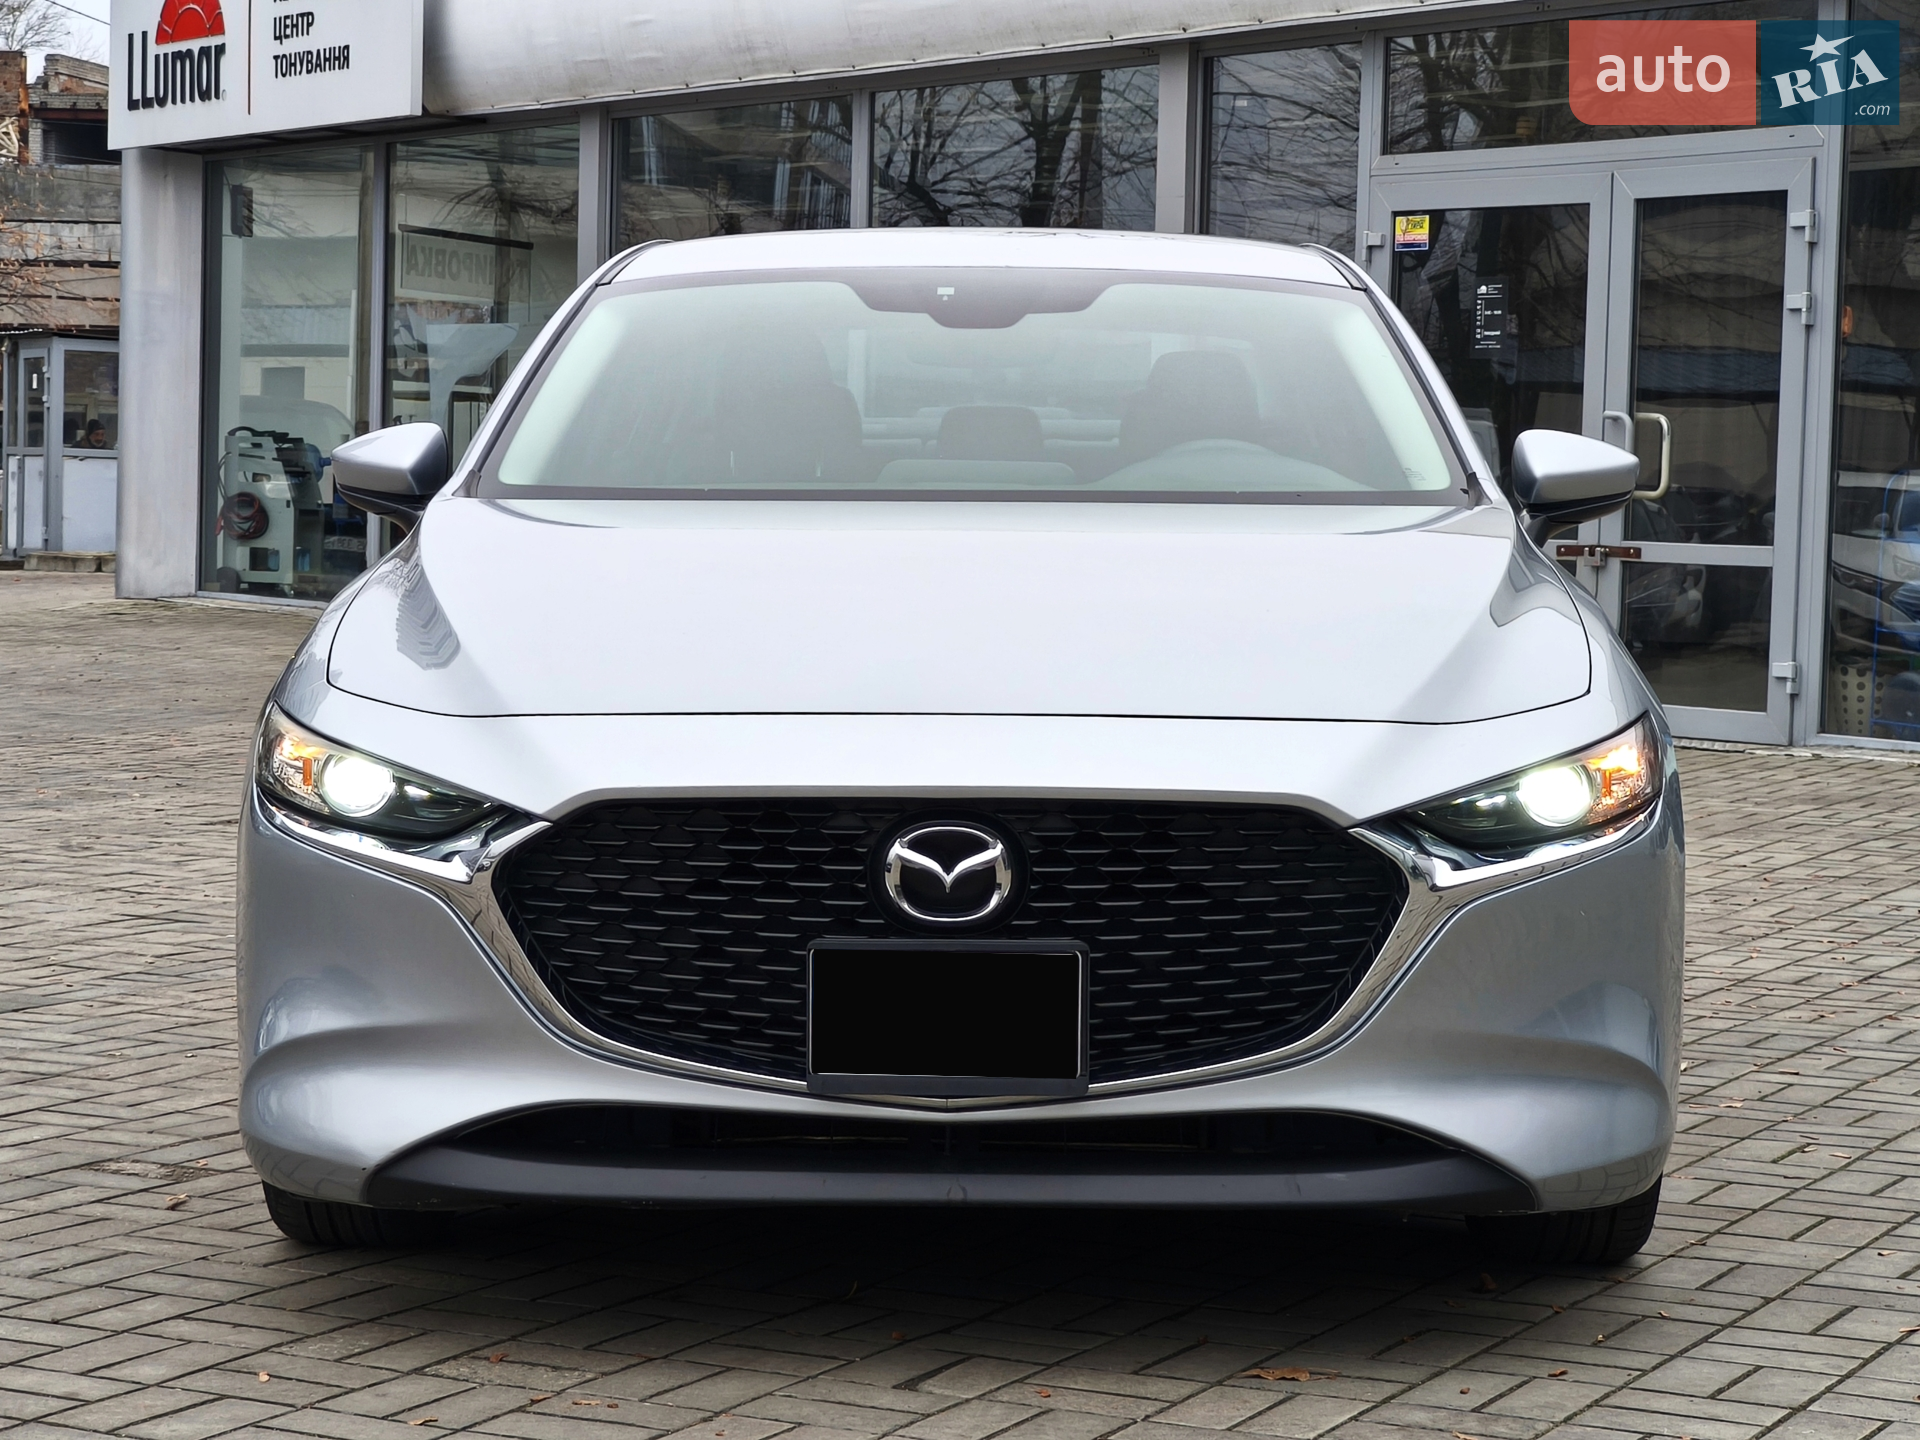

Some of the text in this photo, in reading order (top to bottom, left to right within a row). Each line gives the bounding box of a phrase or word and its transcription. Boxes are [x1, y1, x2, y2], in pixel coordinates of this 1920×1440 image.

[273, 11, 315, 44] ЦЕНТР
[127, 31, 226, 111] LLumar
[273, 44, 350, 79] ТОНУВАННЯ
